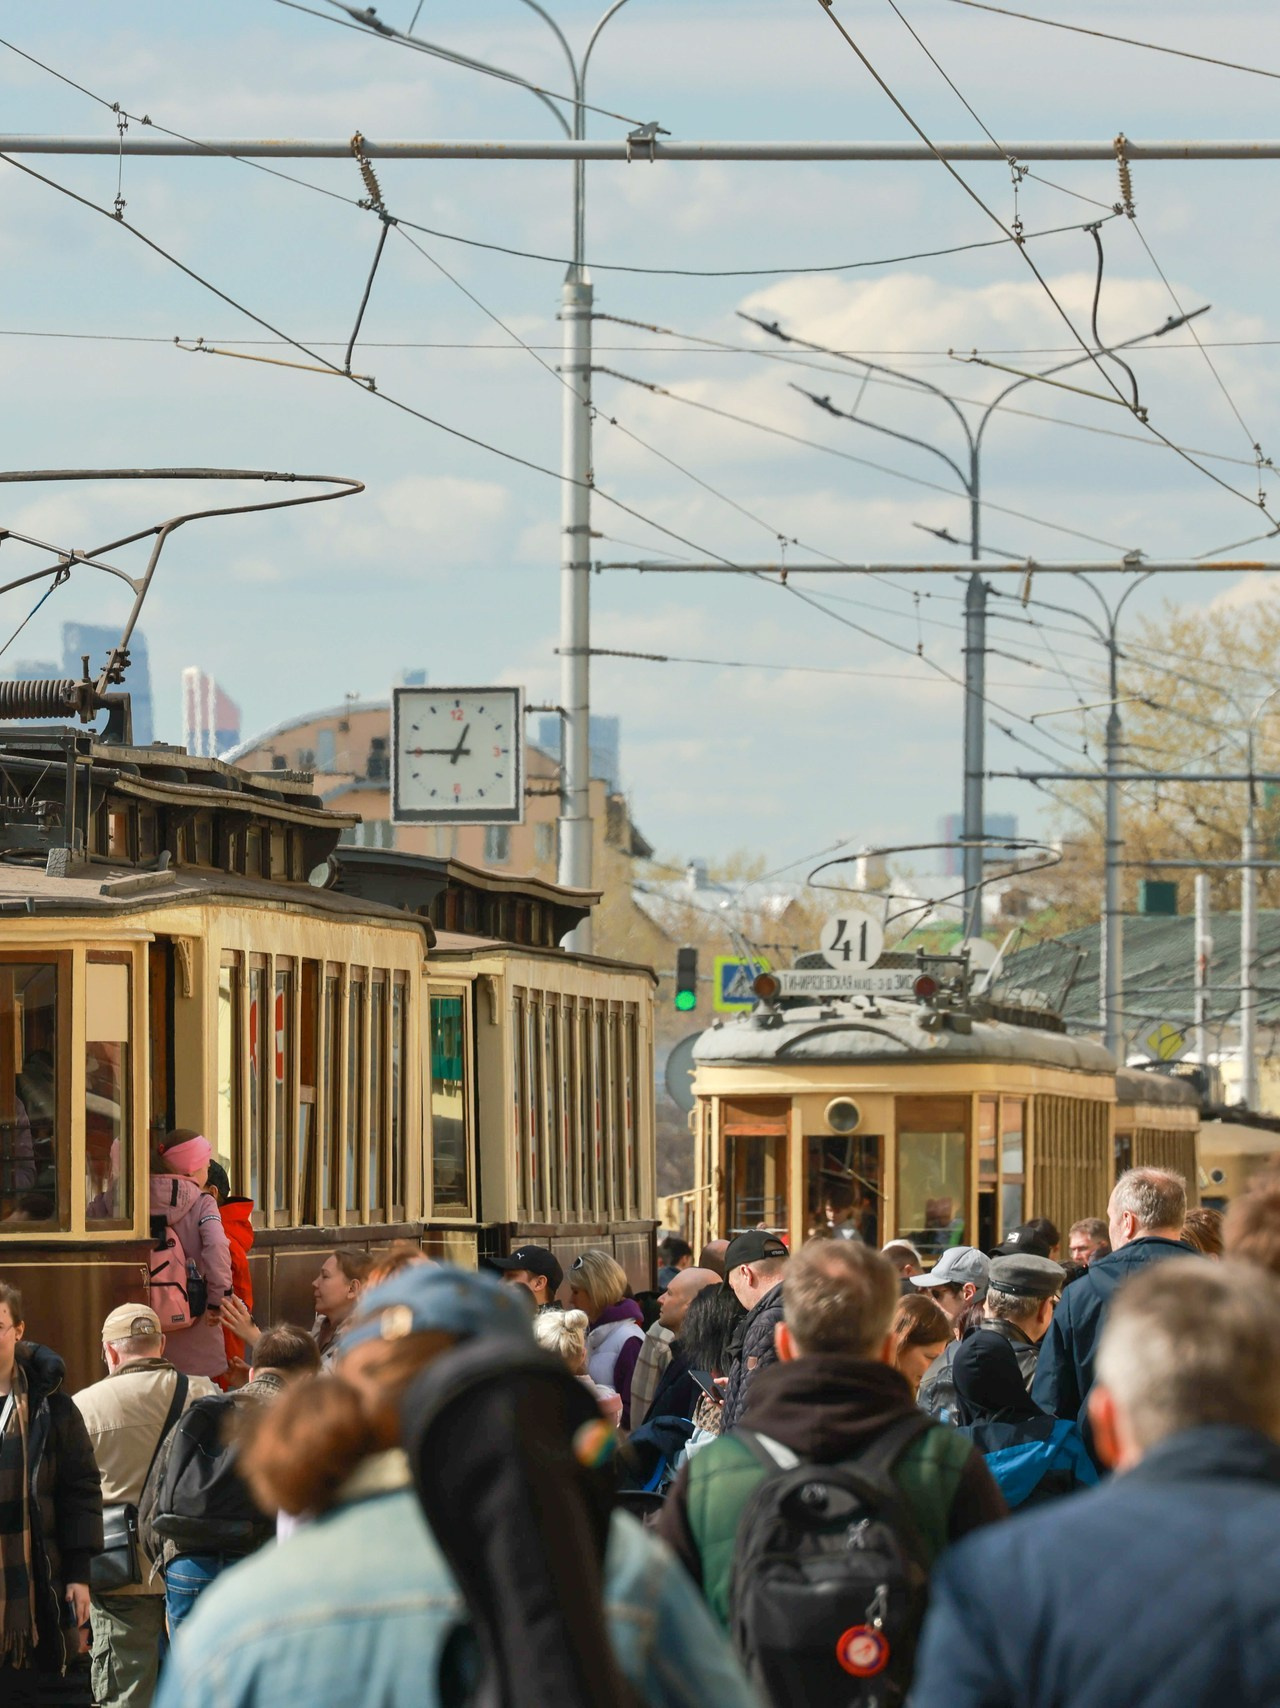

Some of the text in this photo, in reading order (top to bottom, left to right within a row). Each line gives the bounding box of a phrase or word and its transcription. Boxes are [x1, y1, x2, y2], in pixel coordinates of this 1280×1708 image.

[450, 711, 464, 721] 12
[493, 747, 501, 757] 3
[453, 784, 461, 794] 6
[829, 919, 868, 962] 41
